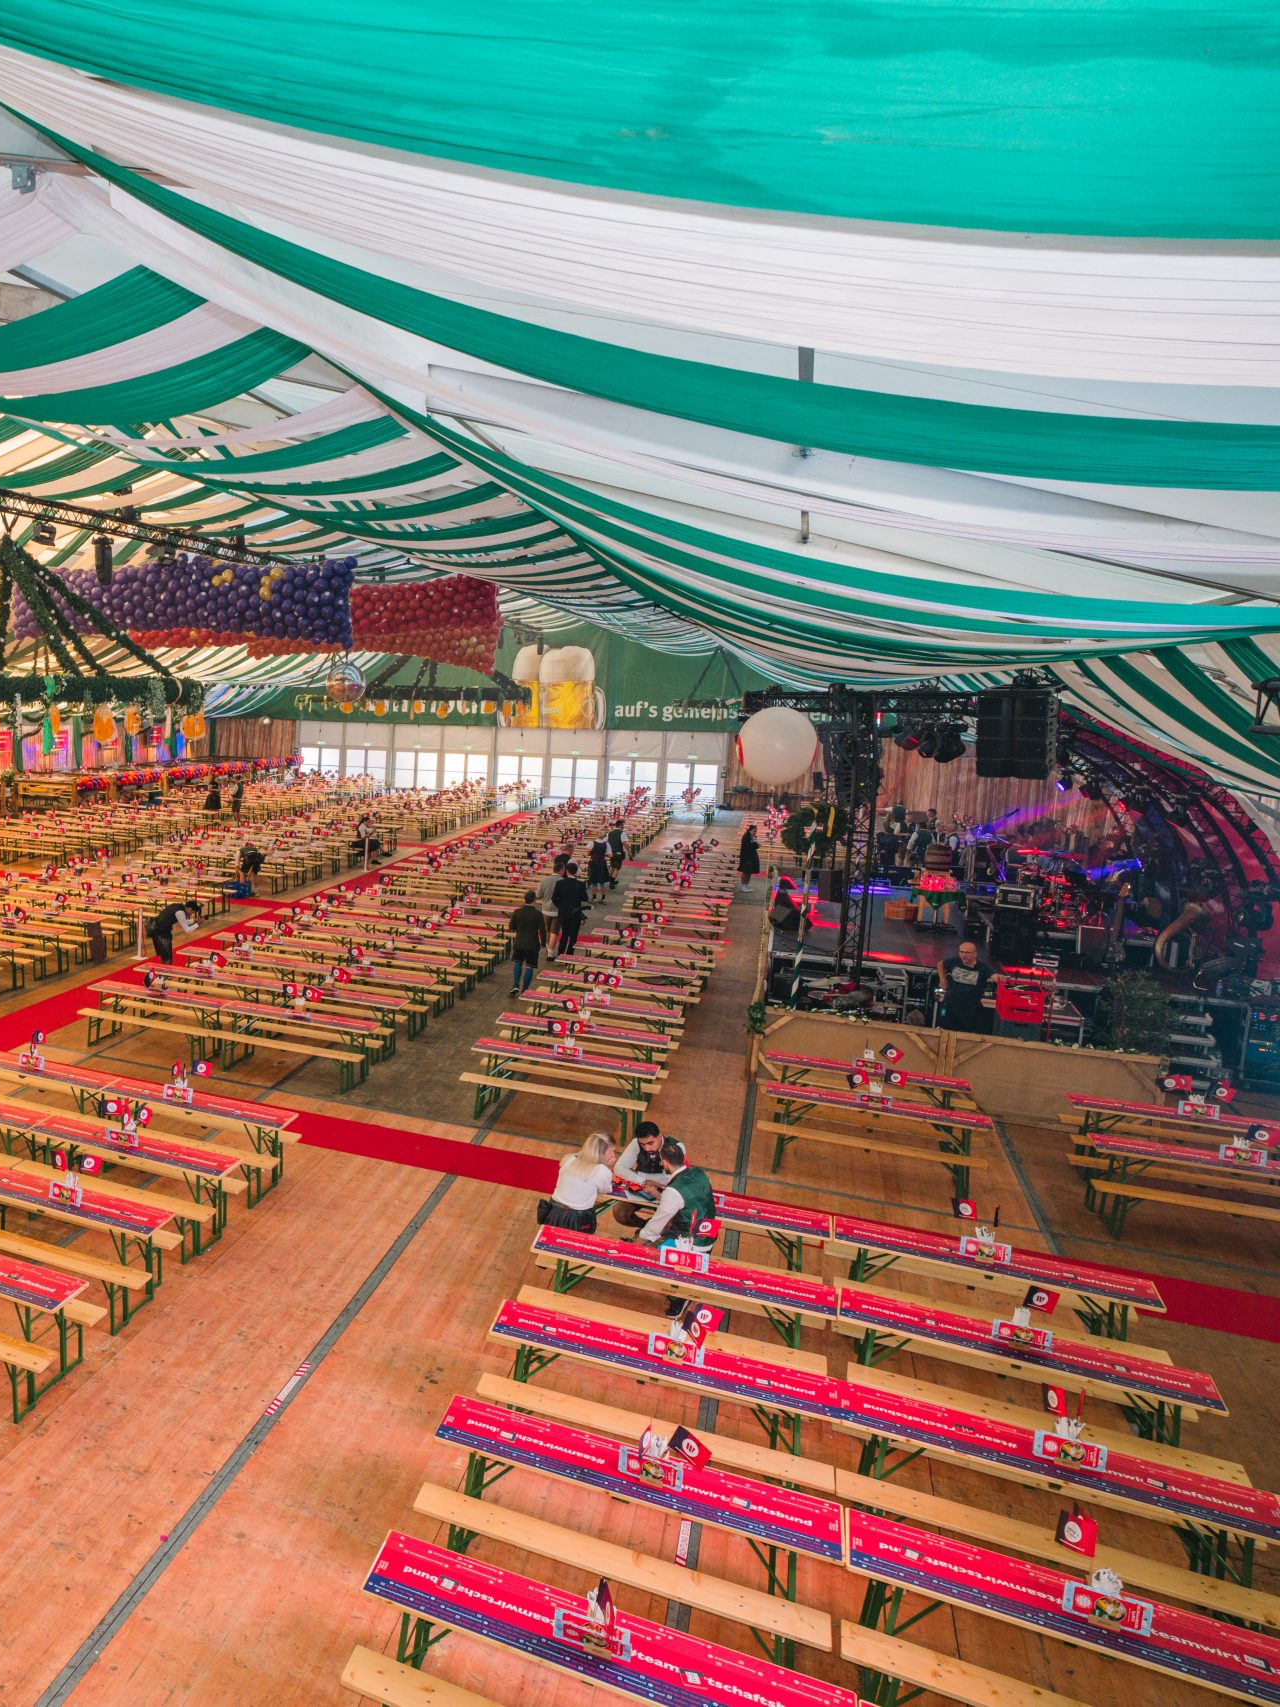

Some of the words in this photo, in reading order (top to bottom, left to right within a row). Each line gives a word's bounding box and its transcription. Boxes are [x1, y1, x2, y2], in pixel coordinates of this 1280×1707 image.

[614, 701, 658, 718] auf's
[466, 1419, 606, 1466] #teamwirtschbund
[403, 1565, 555, 1626] teamwirtschabund
